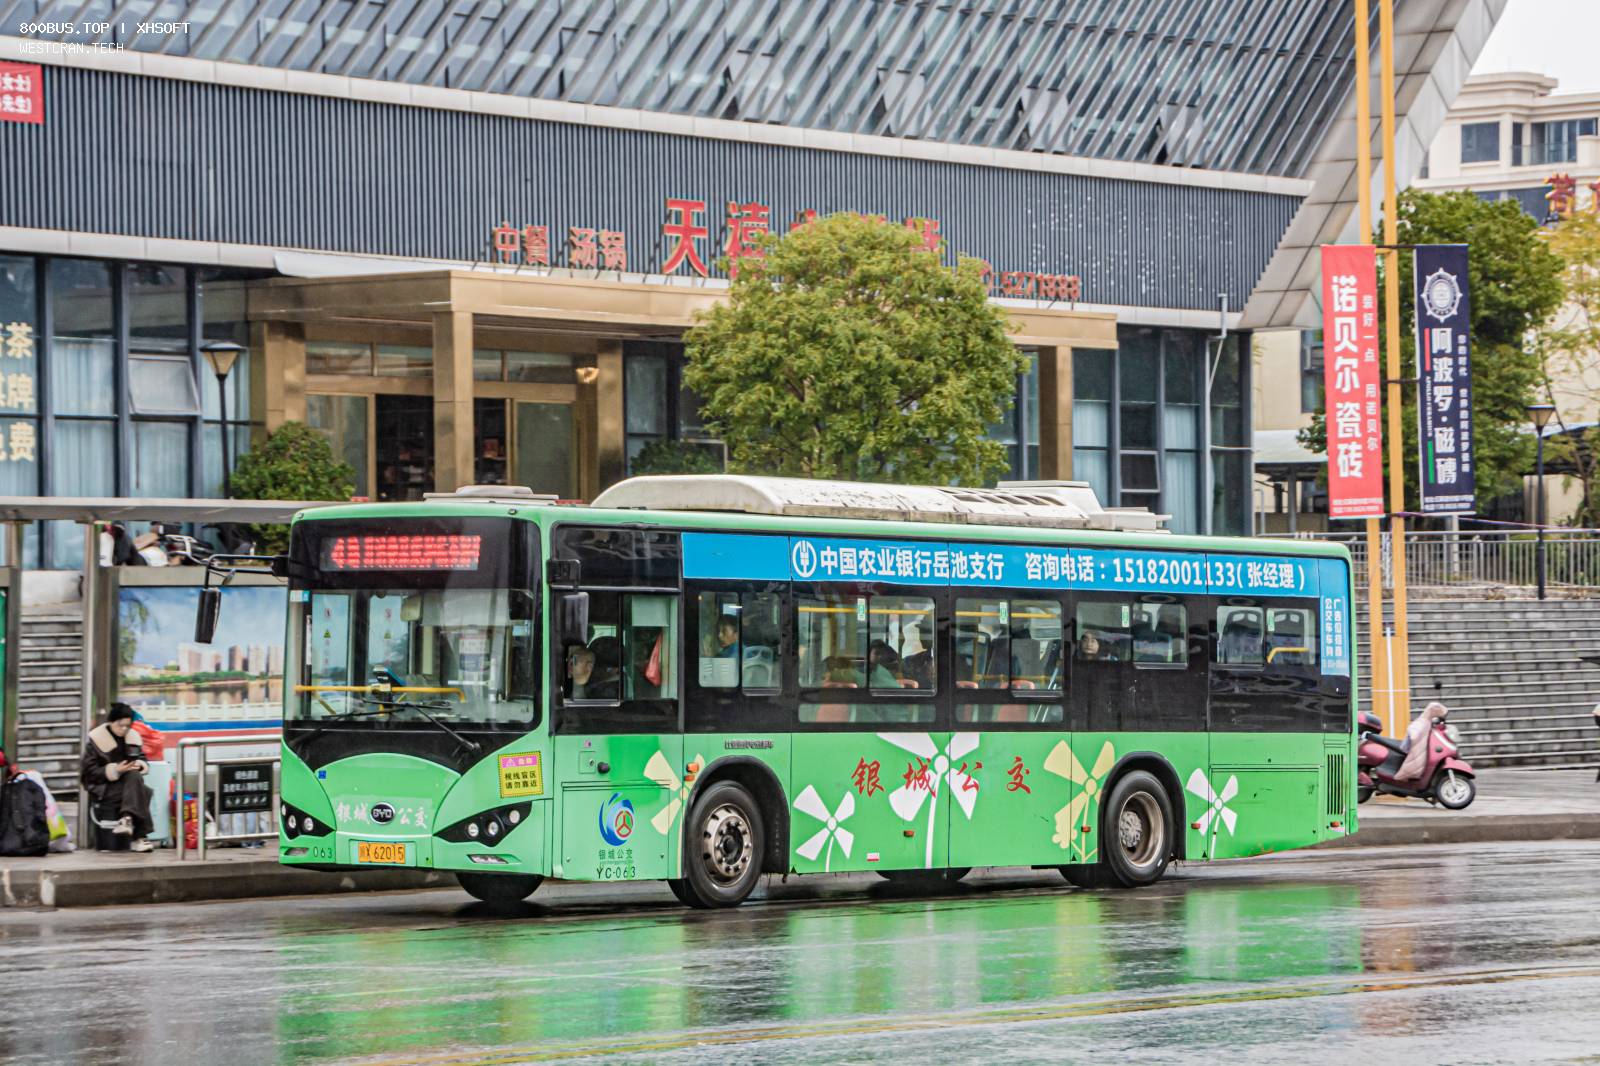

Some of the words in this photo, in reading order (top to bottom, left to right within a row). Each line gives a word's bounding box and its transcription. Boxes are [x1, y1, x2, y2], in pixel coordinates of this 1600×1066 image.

[493, 221, 548, 266] 中餐
[1332, 274, 1363, 479] 诺贝尔瓷砖
[820, 546, 1005, 580] 中国农业银行岳池支行
[852, 756, 1031, 798] 银城公交
[372, 808, 393, 819] BYD
[313, 847, 333, 858] 063
[596, 866, 636, 879] YC-063
